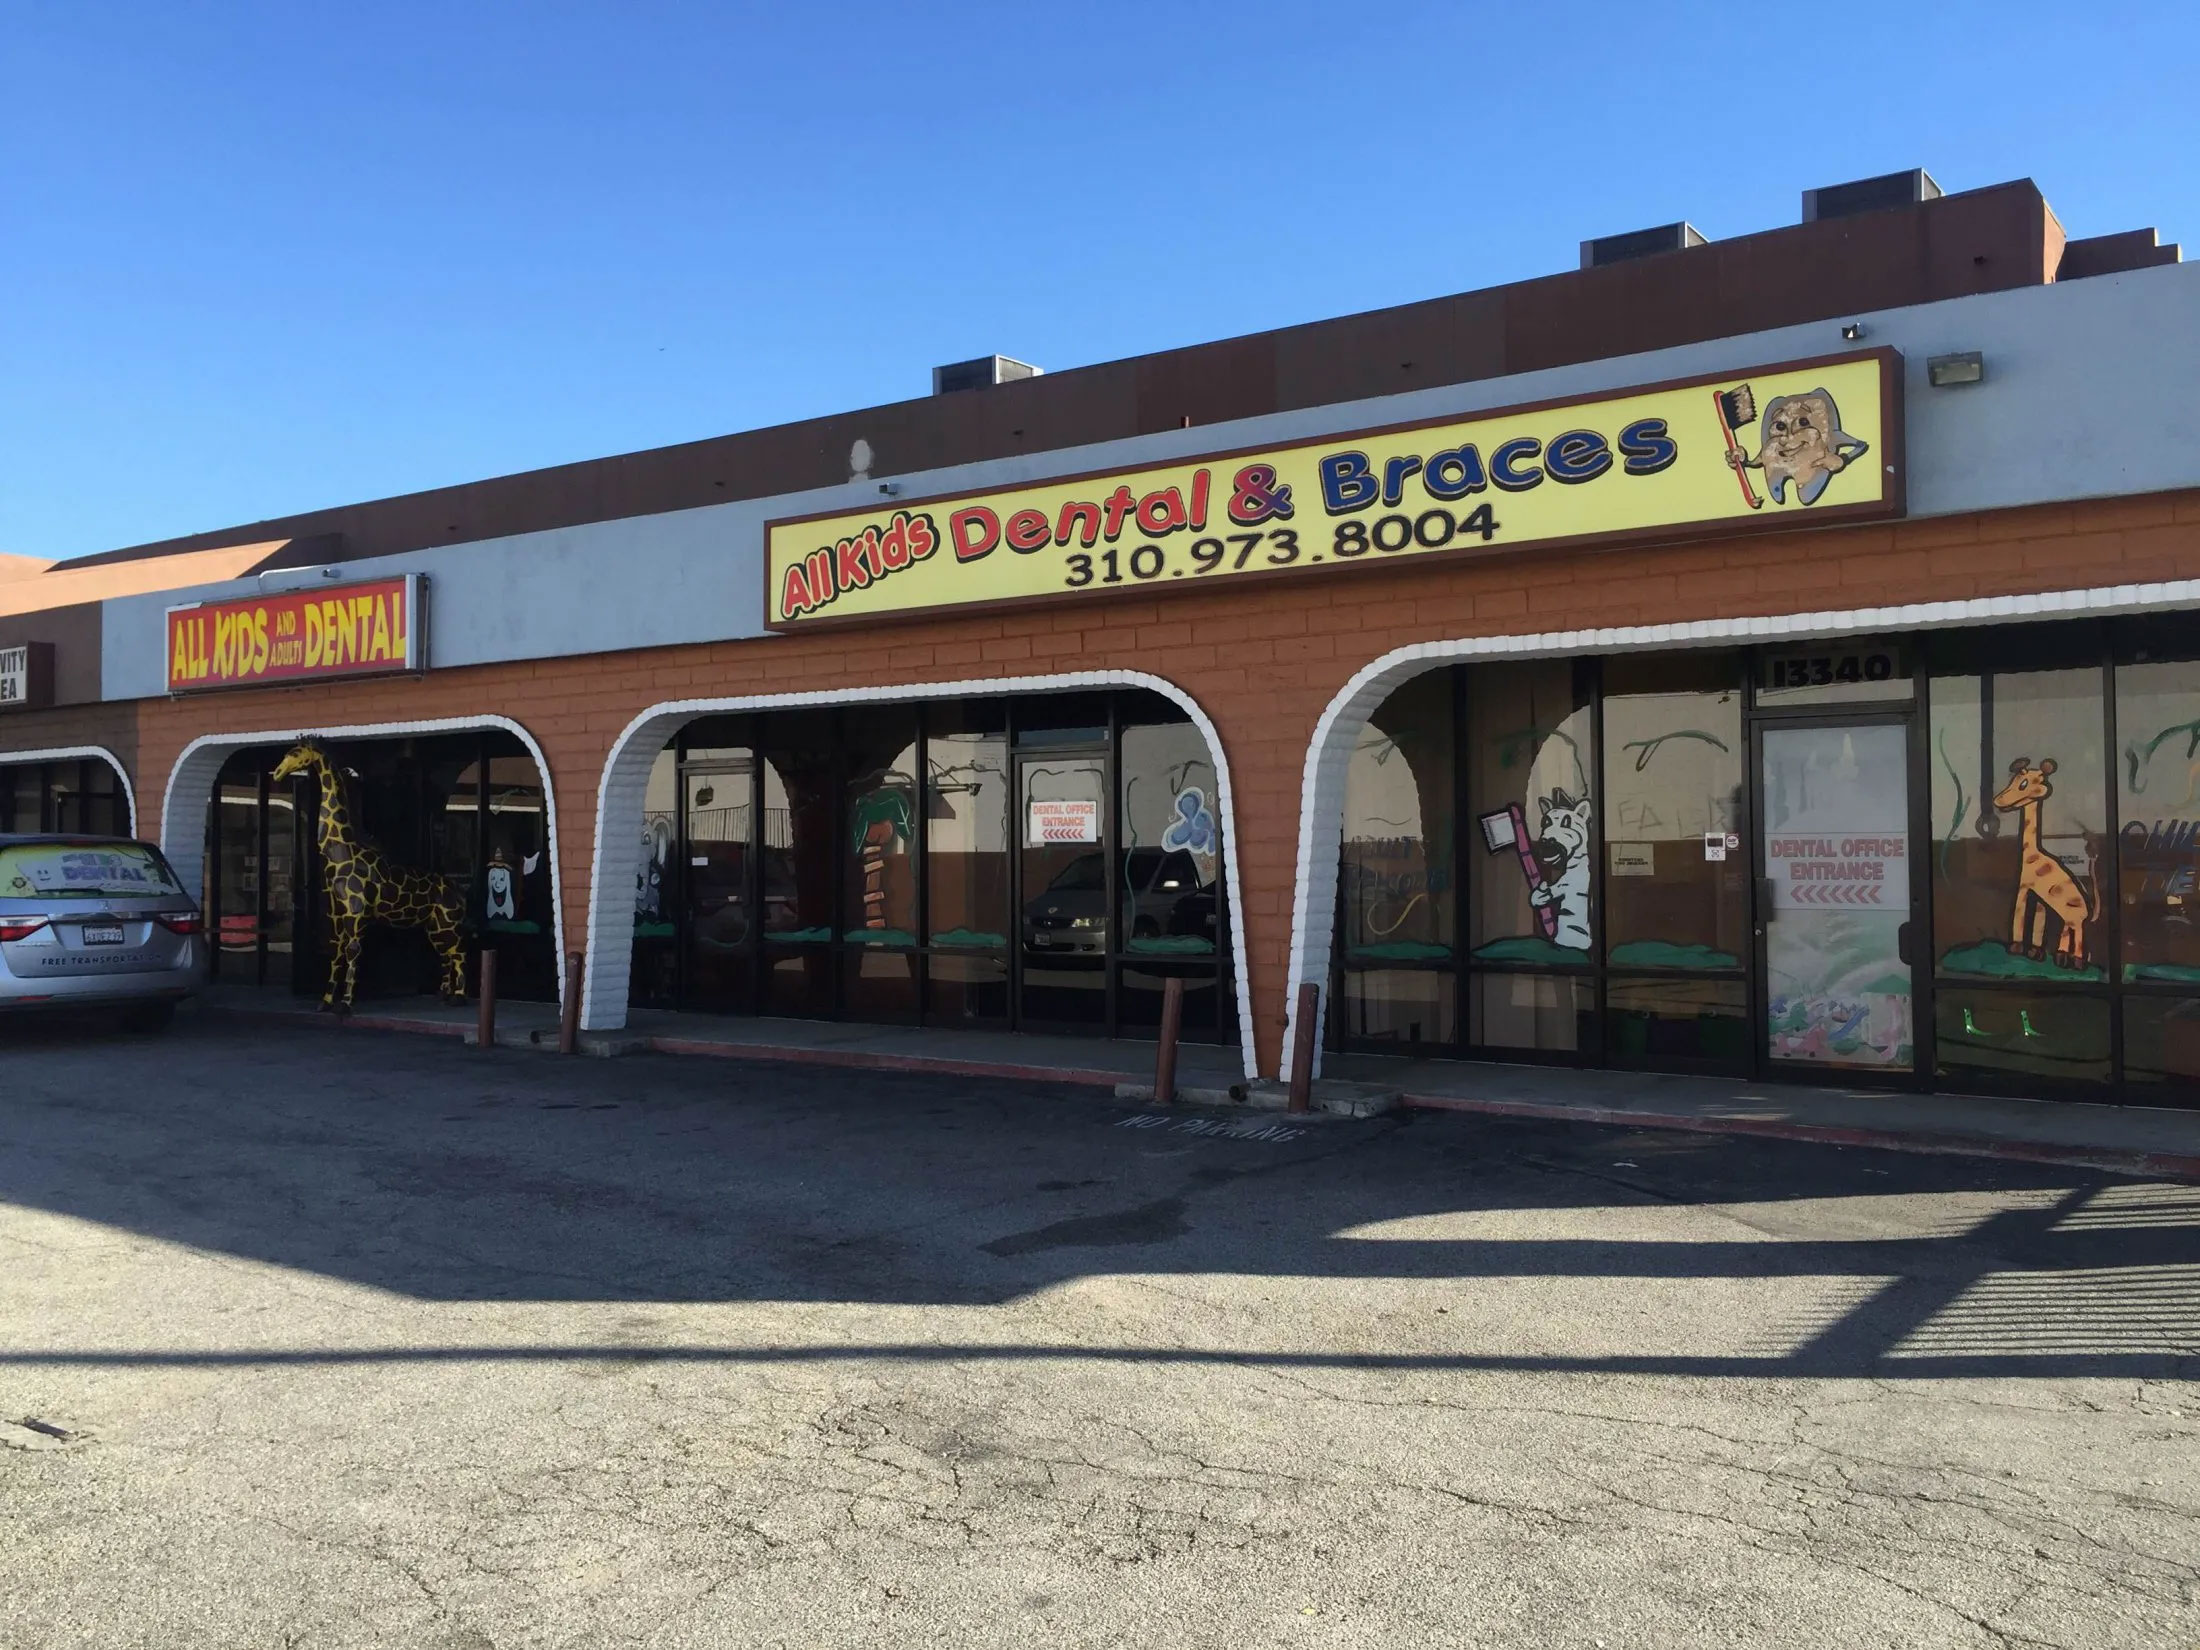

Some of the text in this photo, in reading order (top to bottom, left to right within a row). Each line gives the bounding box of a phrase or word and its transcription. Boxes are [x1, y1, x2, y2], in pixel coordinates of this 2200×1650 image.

[781, 418, 1678, 619] All Kids Dental & Braces
[1064, 503, 1500, 588] 310.973.8004
[276, 610, 296, 637] AND
[304, 592, 406, 668] DENTAL
[172, 607, 270, 680] ALL KIDS
[269, 640, 303, 667] ADULTS
[1774, 654, 1892, 687] 13340
[1033, 804, 1095, 815] DENTAL OFFICE
[1042, 816, 1086, 827] ENTRANCE
[1770, 838, 1905, 858] DENTAL OFFICE
[1790, 861, 1885, 881] ENTRANCE
[42, 957, 67, 966] FREE
[72, 954, 161, 964] TRANSPORTATON
